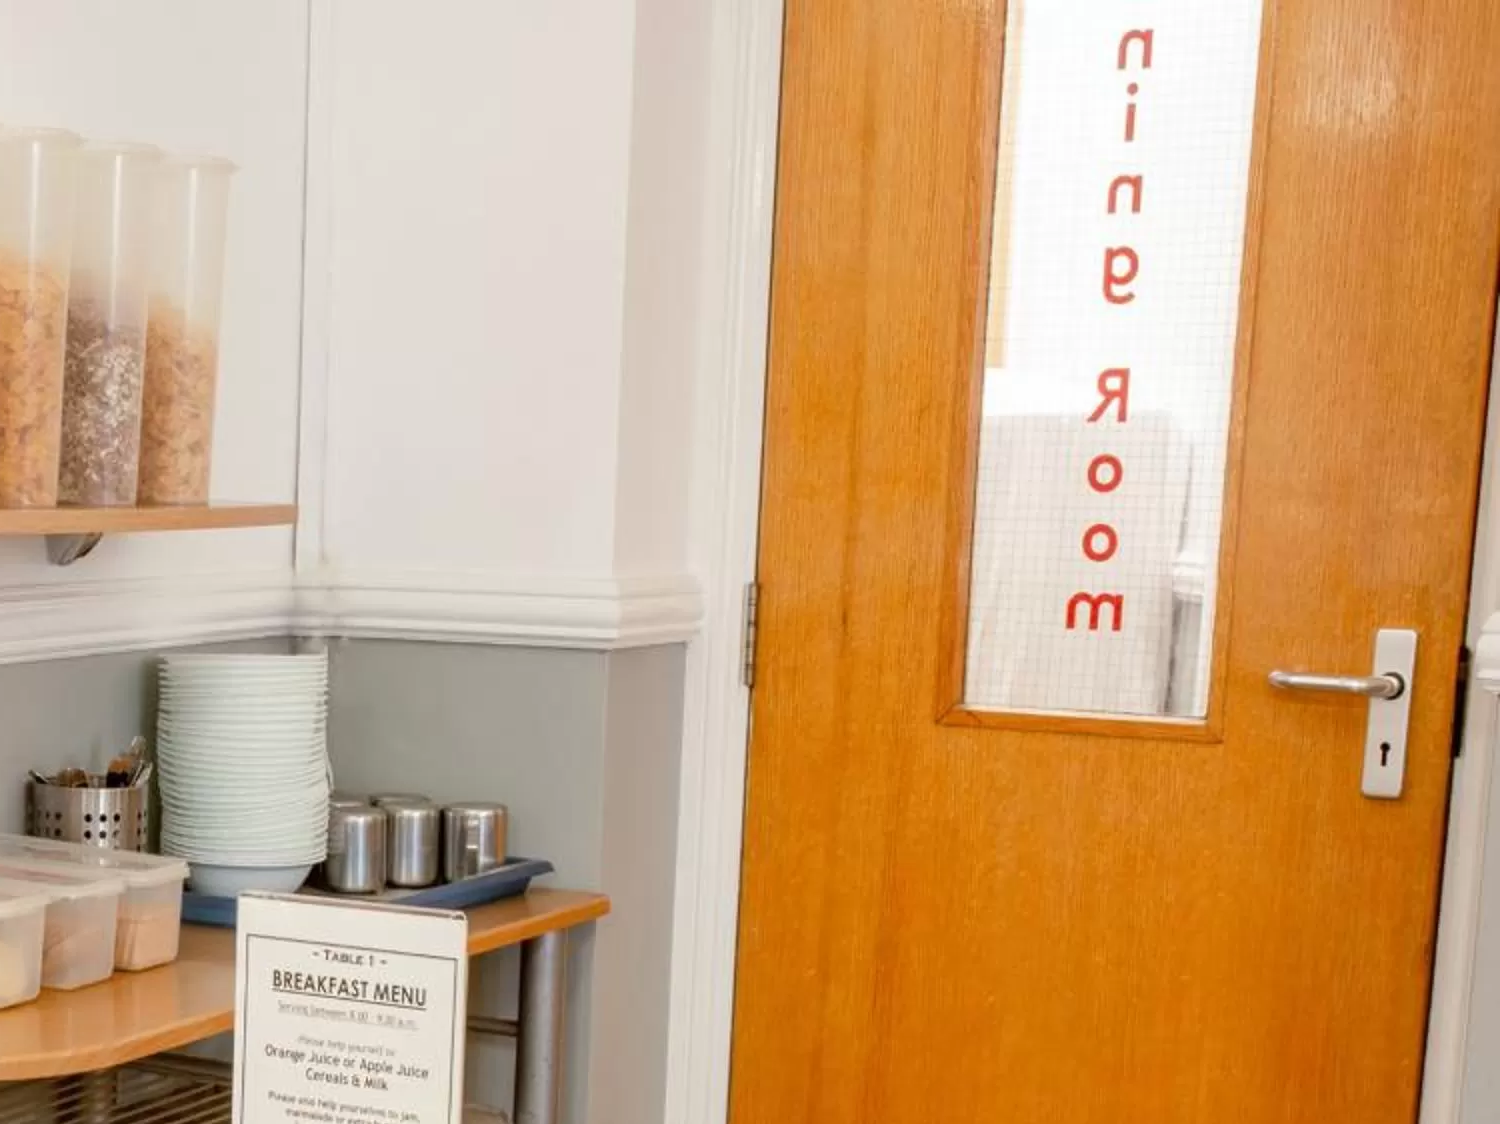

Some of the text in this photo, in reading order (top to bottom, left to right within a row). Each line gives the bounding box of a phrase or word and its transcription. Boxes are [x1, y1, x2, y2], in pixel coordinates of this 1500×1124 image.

[272, 969, 427, 1006] BREAKFAST MENU
[264, 1043, 429, 1079] Orange Juice or Apple Juice
[305, 1067, 388, 1090] Cereals & Milk
